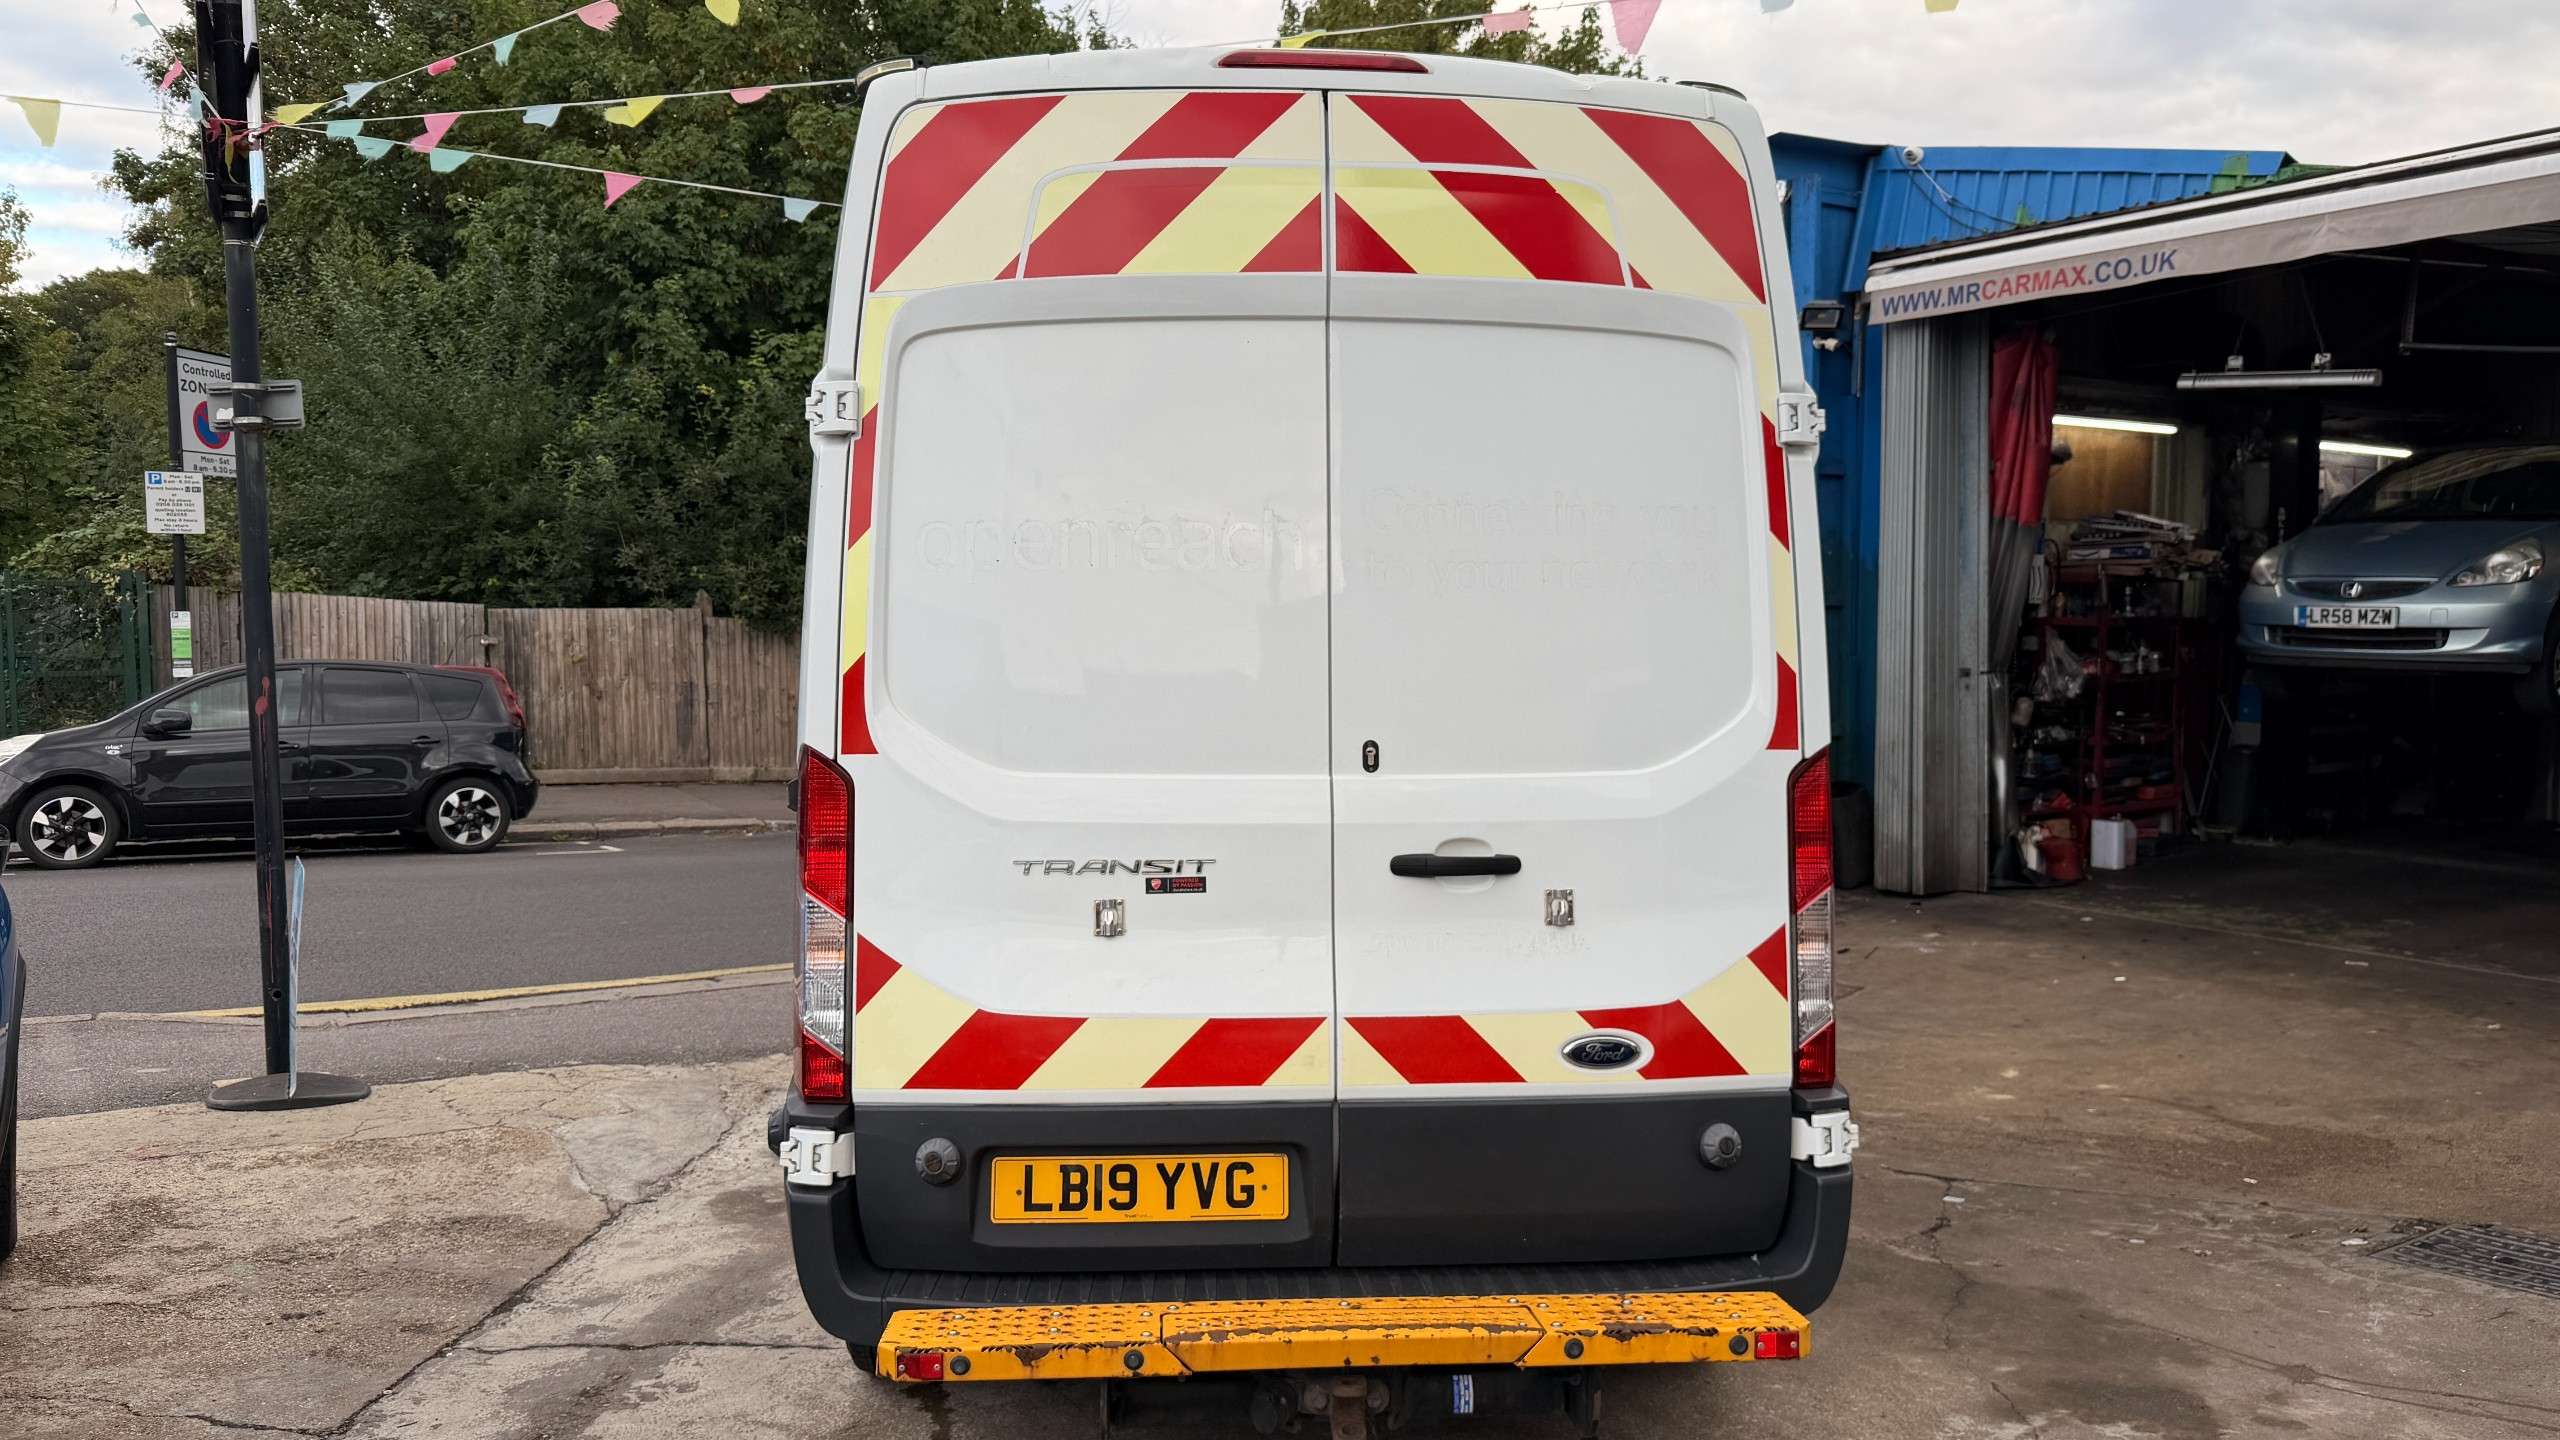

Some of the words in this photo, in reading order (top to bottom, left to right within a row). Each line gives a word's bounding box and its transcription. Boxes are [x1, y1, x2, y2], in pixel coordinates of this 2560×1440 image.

[1882, 249, 2177, 317] WWW.MRCARMAX.CO.UK
[182, 362, 231, 381] Controlled
[180, 379, 207, 395] ZON
[915, 506, 1304, 584] openreach
[2308, 608, 2351, 624] LR58
[2358, 608, 2392, 625] MZW
[1012, 859, 1217, 876] TRANSIT
[1582, 1043, 1624, 1062] Ford
[1023, 1163, 1138, 1213] LB19
[1156, 1161, 1255, 1210] YVG
